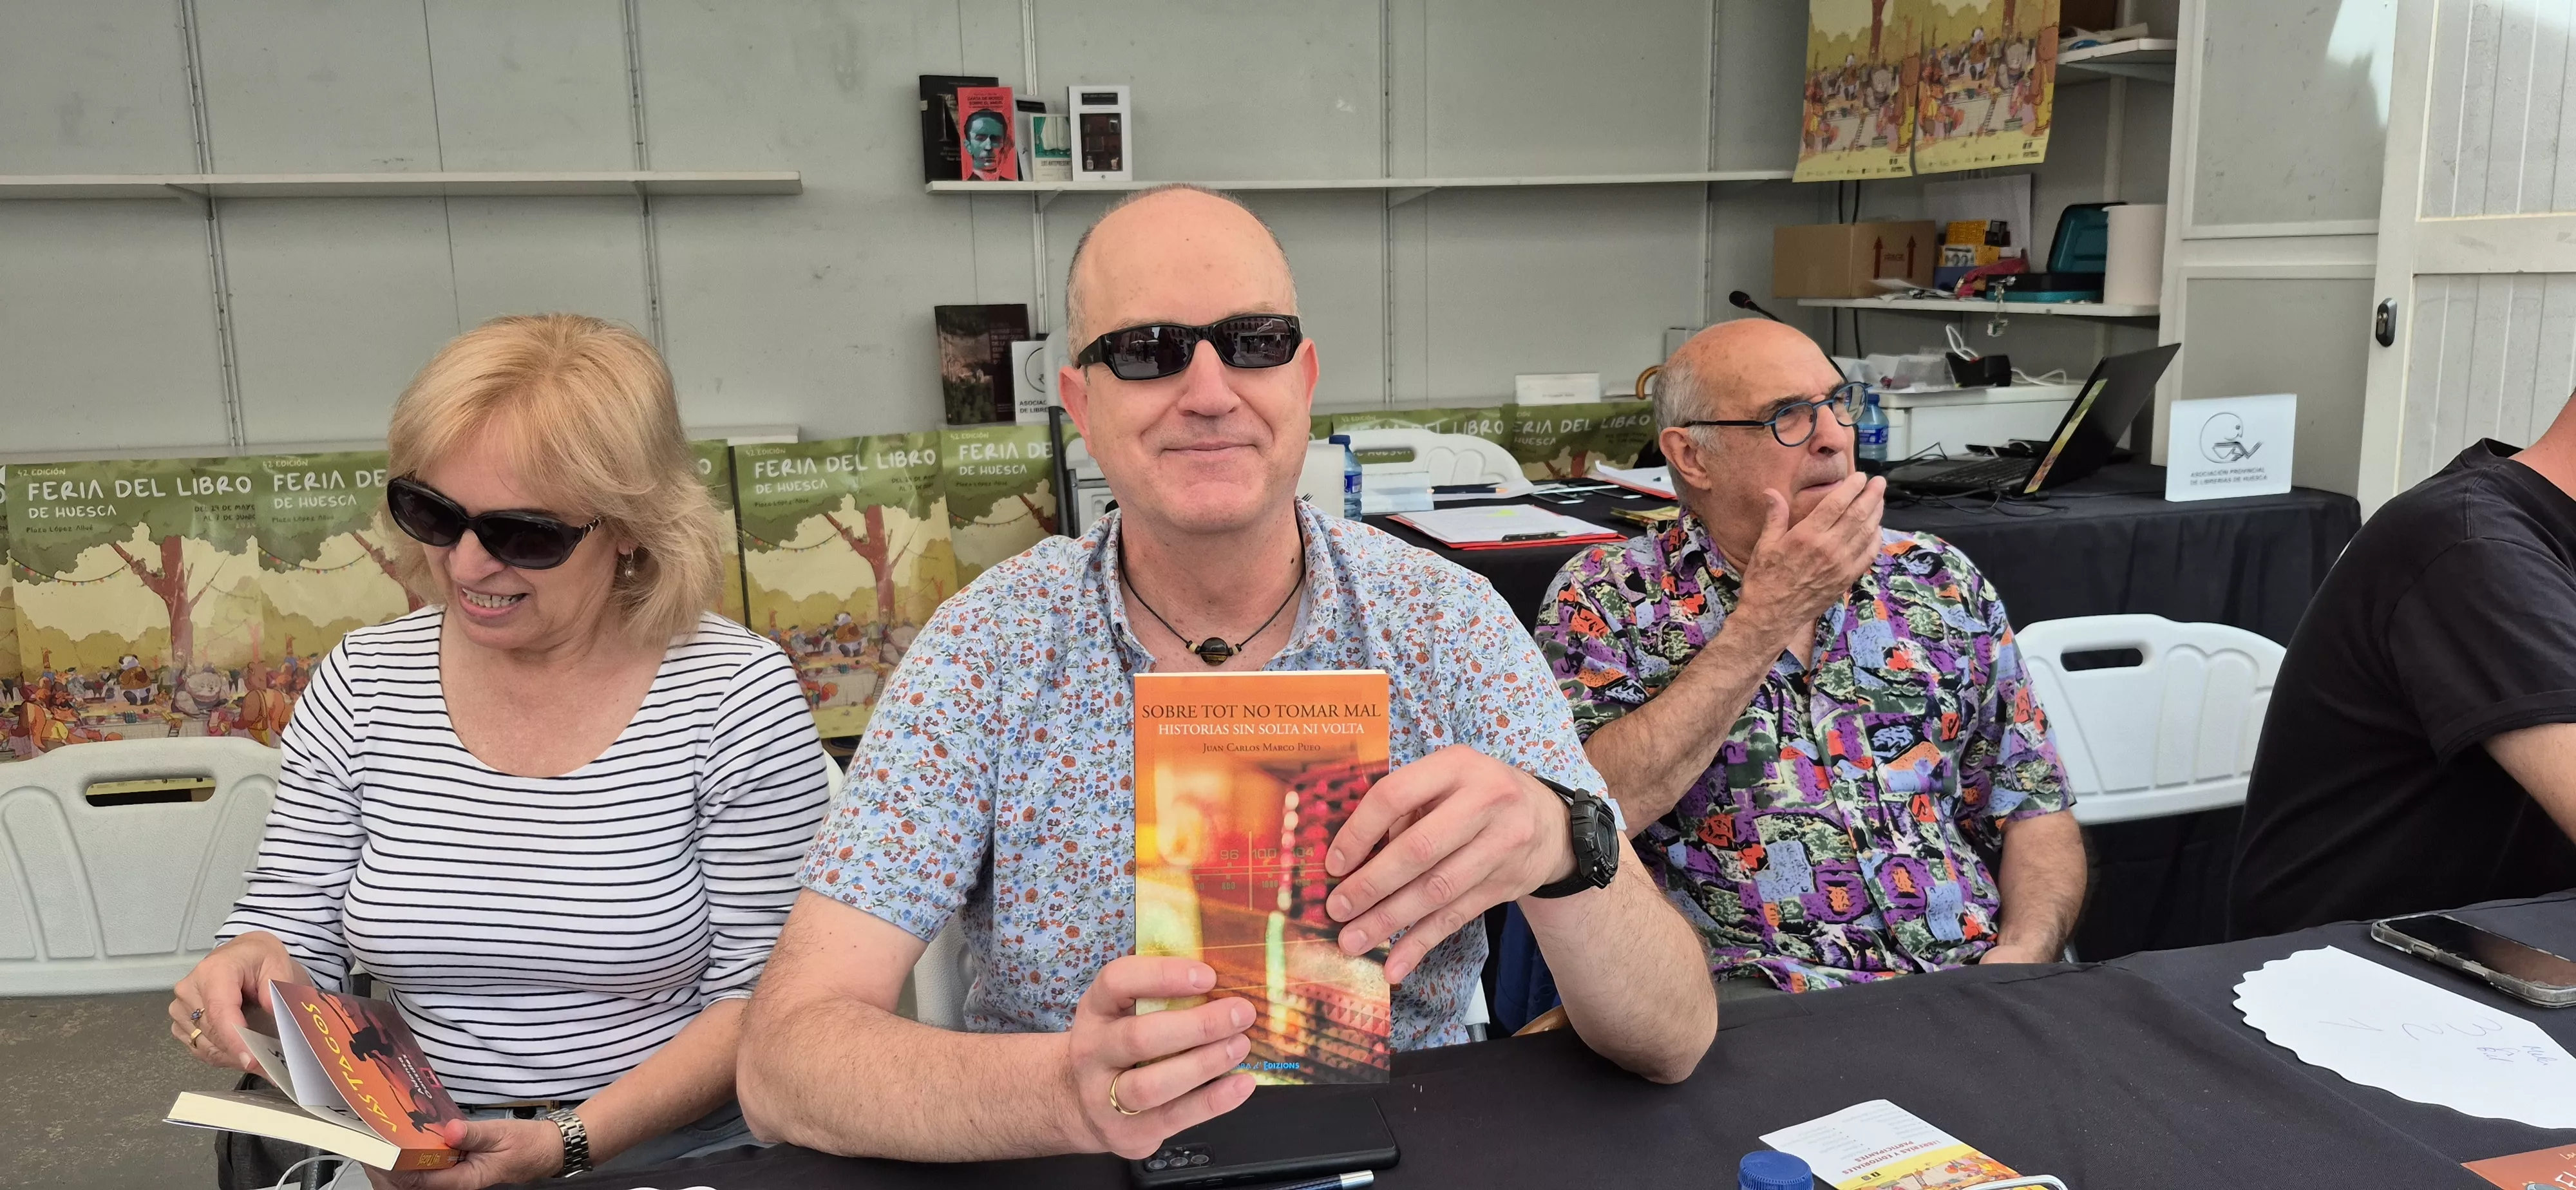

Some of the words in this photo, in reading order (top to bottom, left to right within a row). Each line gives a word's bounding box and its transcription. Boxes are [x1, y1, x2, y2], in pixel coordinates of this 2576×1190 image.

[1560, 419, 1592, 433] DEL
[1601, 414, 1651, 430] LIBRO
[959, 442, 1019, 461] FERIA
[276, 459, 308, 468] EDICIÓN
[754, 457, 817, 478] FERIA
[826, 455, 868, 473] DEL
[876, 449, 936, 470] LIBRO
[959, 466, 975, 476] DE
[980, 464, 1027, 475] HUESCA
[32, 468, 66, 476] EDICIÓN
[28, 479, 104, 501] FERIA
[115, 477, 166, 498] DEL
[176, 476, 252, 496] LIBRO
[274, 469, 346, 492] FERIA
[755, 483, 773, 495] DE
[777, 478, 828, 493] HUESCA
[274, 497, 293, 509] DE
[299, 494, 357, 508] HUESCA
[28, 507, 49, 518] DE
[55, 504, 117, 518] HUESCA
[1141, 704, 1197, 719] SOBRE
[1201, 704, 1238, 719] TOT
[1243, 704, 1271, 719] NO
[1274, 703, 1338, 718] TOMAR
[1344, 703, 1381, 717] MAL
[1159, 724, 1229, 736] HISTORIAS
[1233, 724, 1255, 735] SIN
[1259, 723, 1299, 735] SOLTA
[1303, 723, 1318, 735] NI
[1323, 722, 1365, 735] VOLTA
[1220, 849, 1240, 860] 96
[1251, 847, 1278, 859] 100
[1854, 1140, 1915, 1163] PARTICIPANTES
[1842, 1154, 1893, 1175] EDITORIALES
